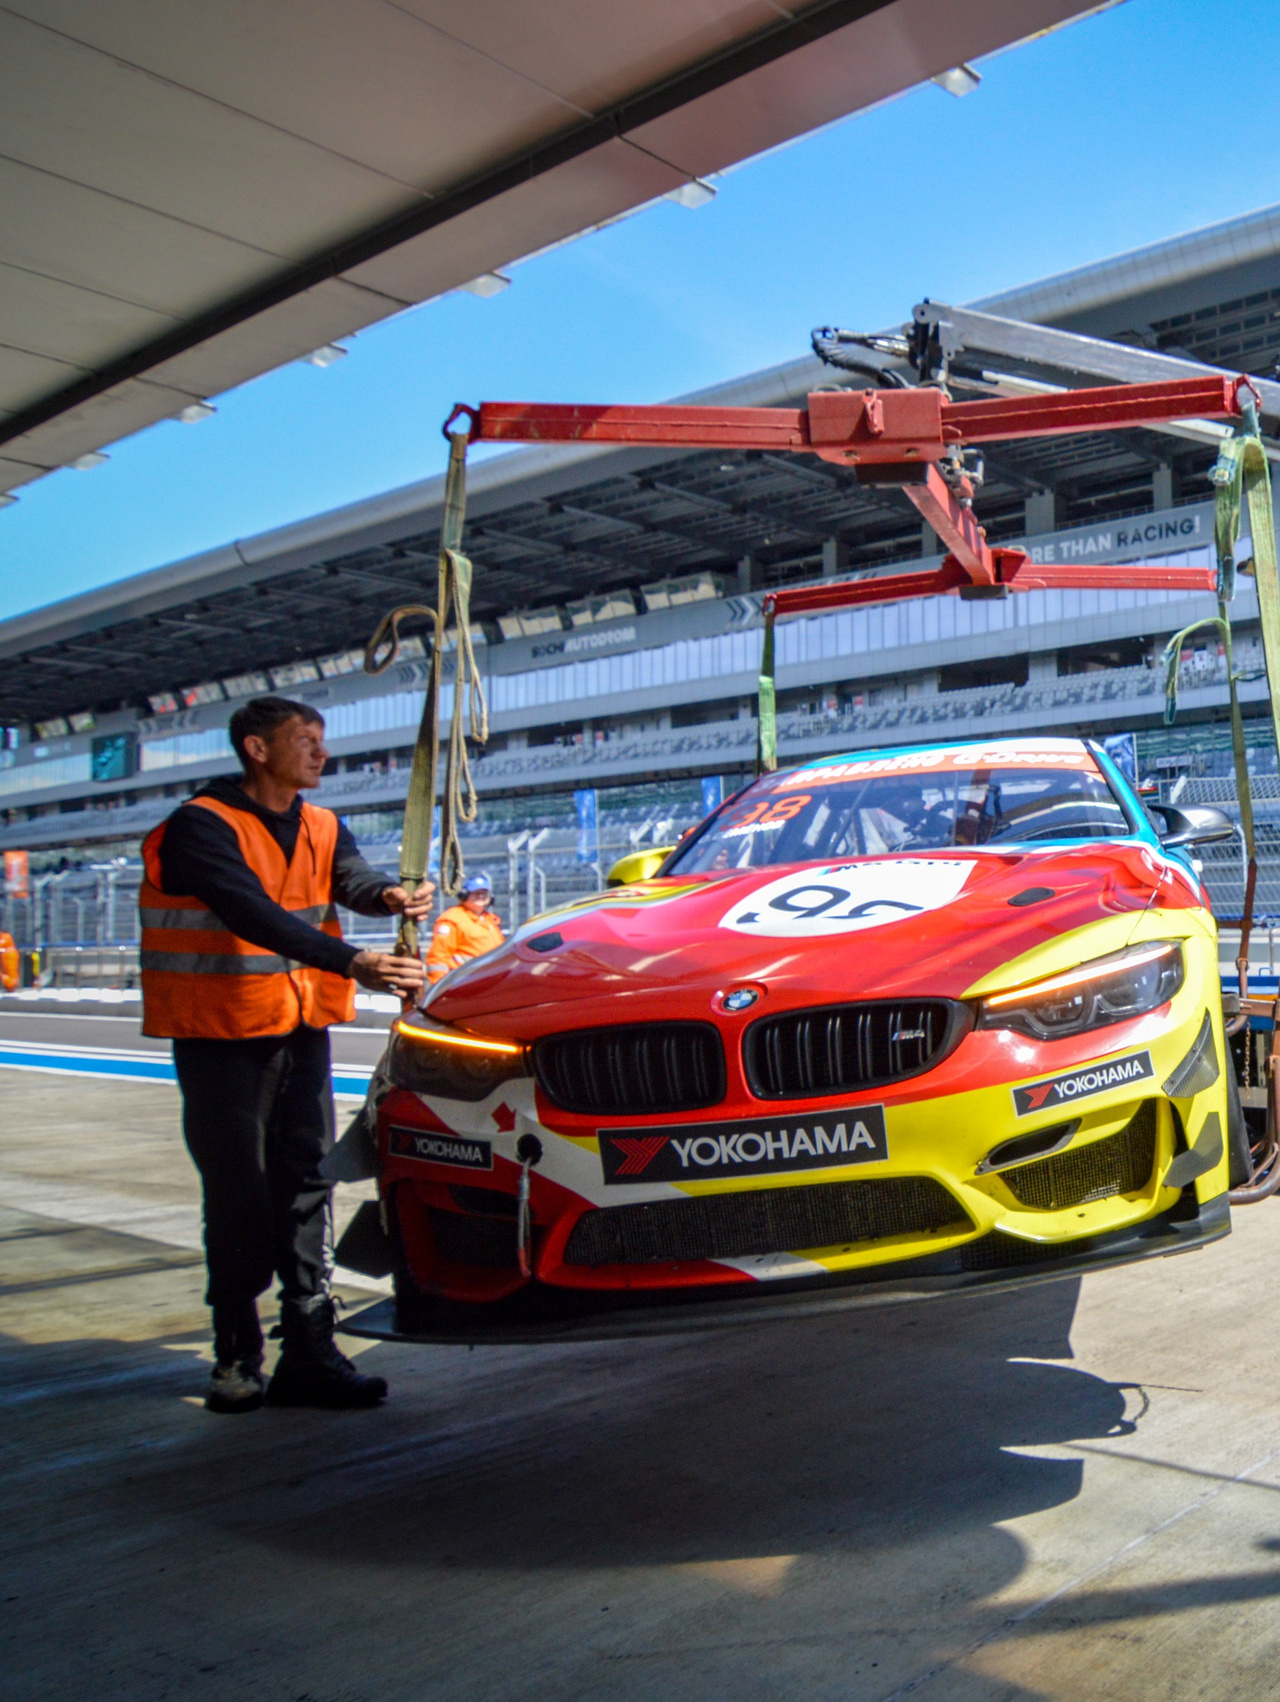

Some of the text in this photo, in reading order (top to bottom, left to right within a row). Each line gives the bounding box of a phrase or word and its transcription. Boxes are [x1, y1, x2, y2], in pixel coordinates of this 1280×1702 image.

[1059, 533, 1112, 559] THAN
[1117, 514, 1200, 548] RACING!
[1053, 1057, 1144, 1098] YOKOHAMA
[415, 1137, 483, 1162] YOKOHAMA
[671, 1120, 876, 1167] YOKOHAMA
